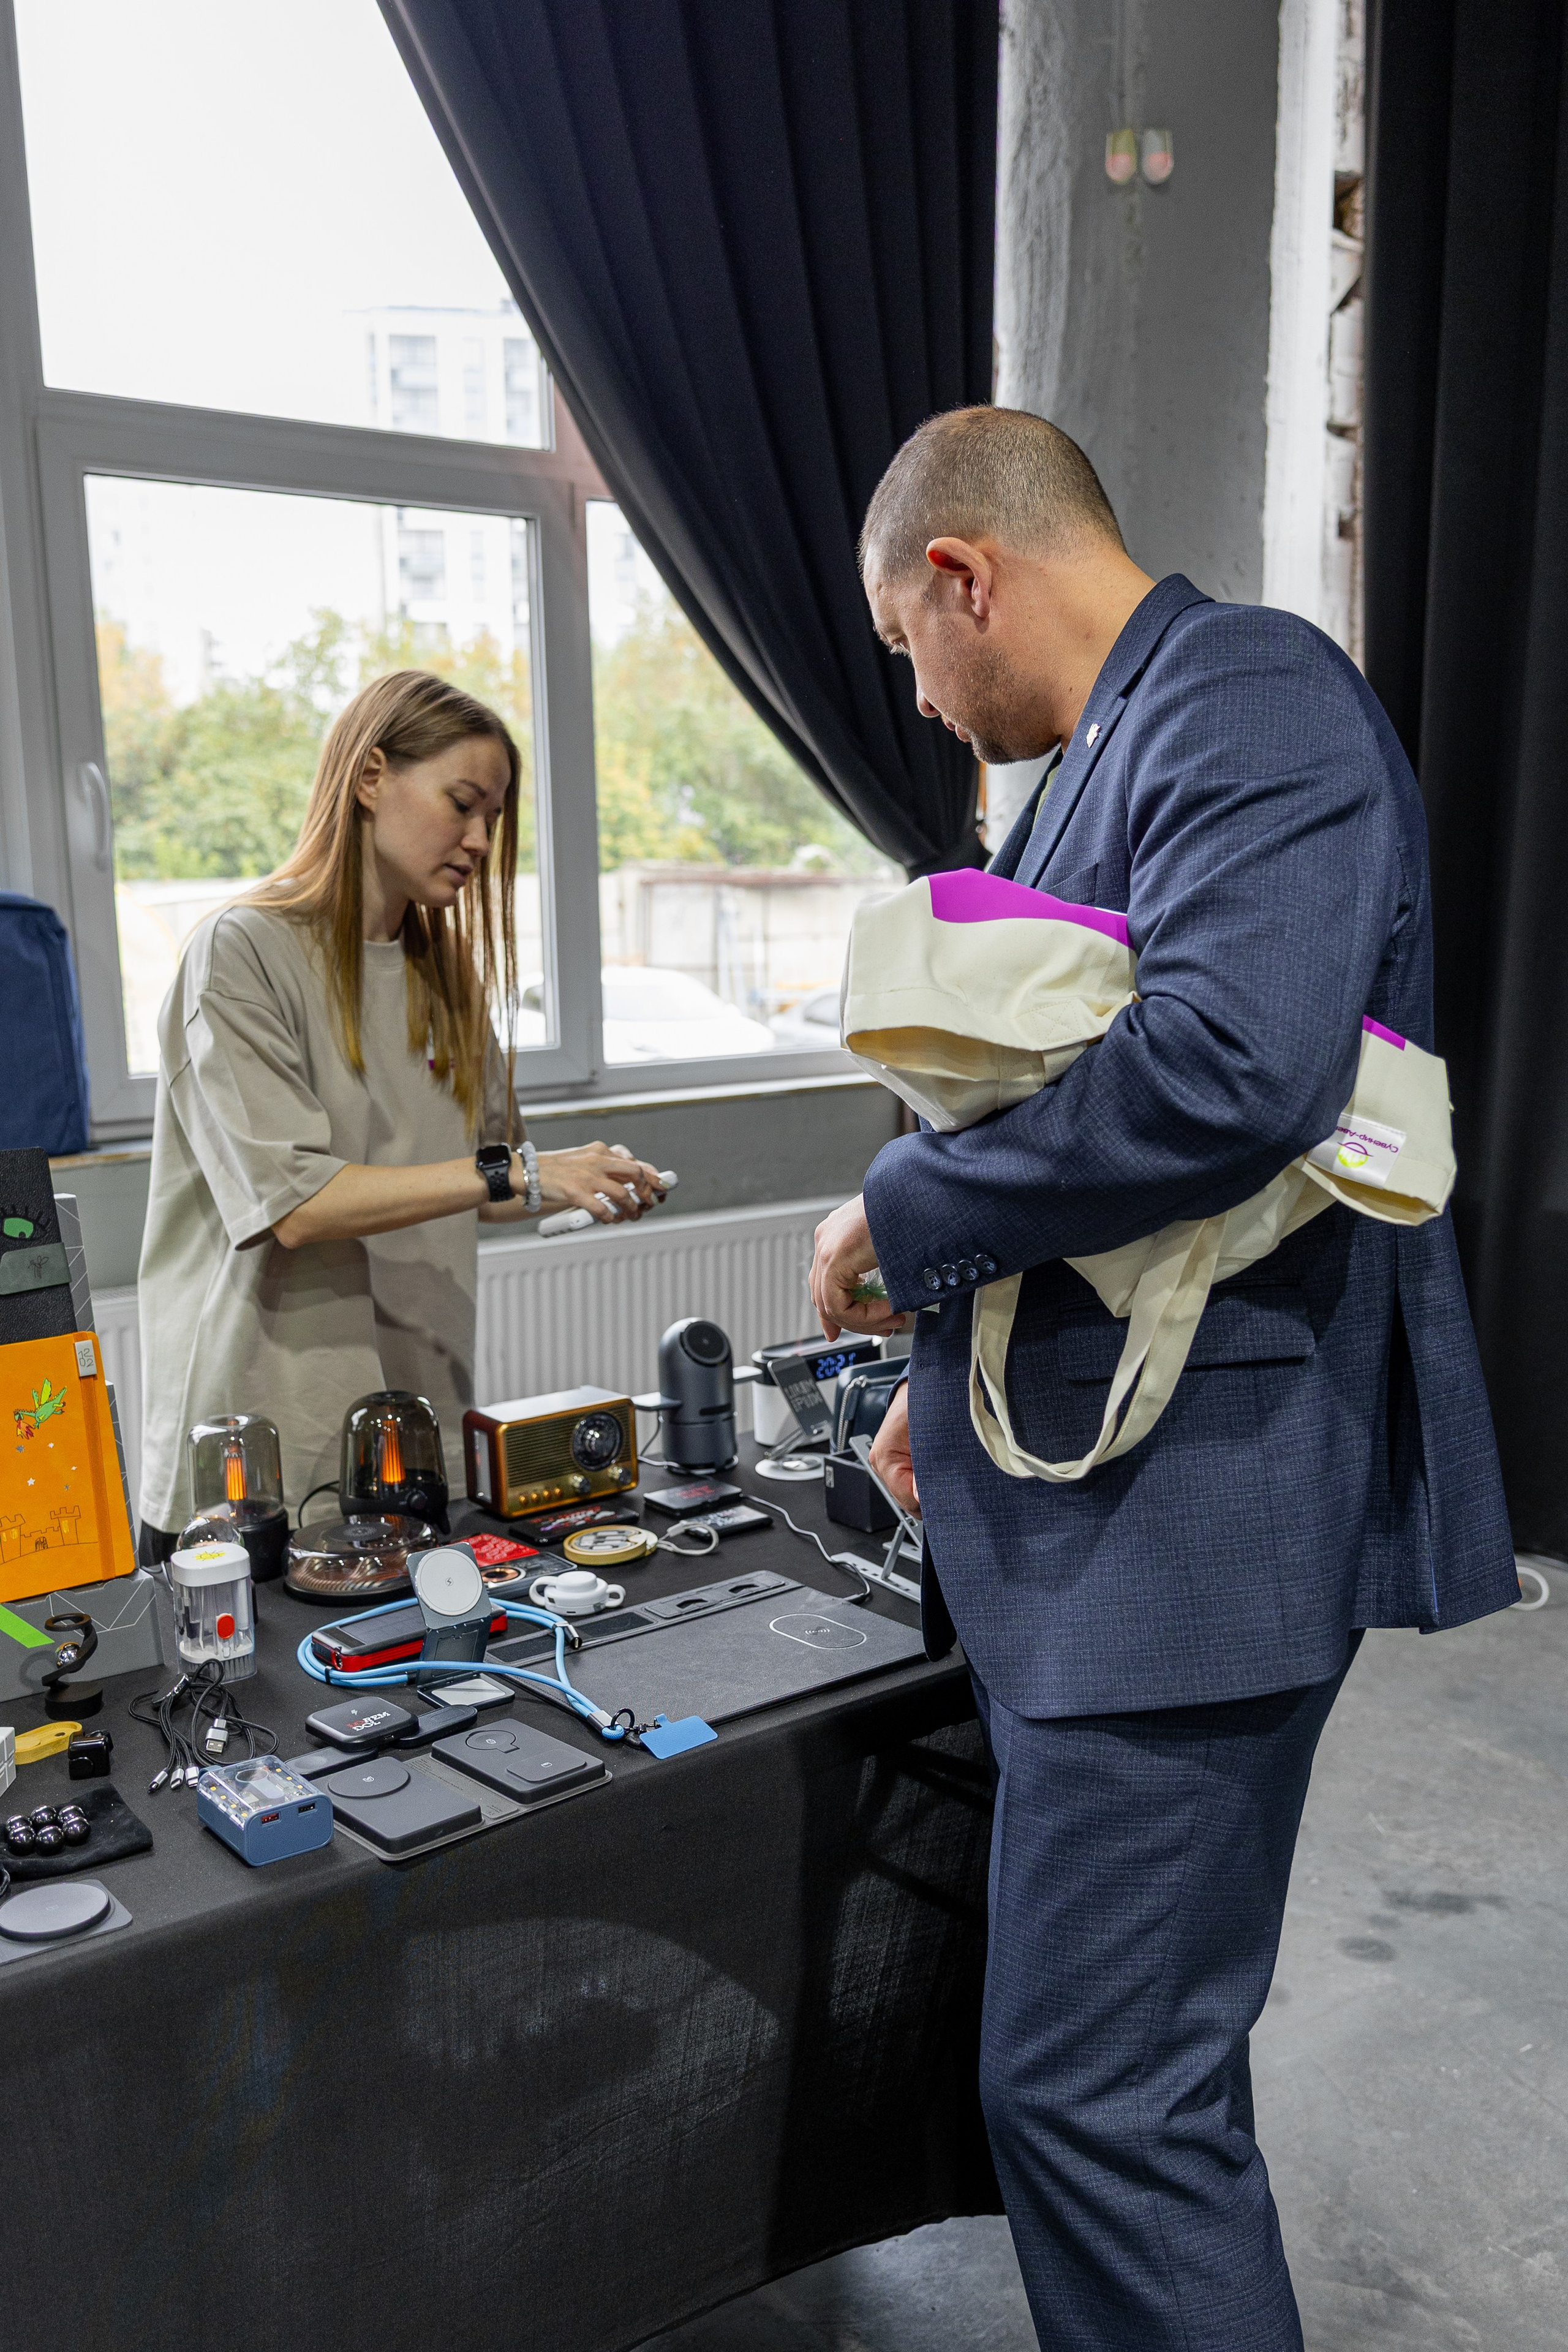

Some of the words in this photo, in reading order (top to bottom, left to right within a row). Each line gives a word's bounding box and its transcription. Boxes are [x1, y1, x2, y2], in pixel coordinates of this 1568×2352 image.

[78, 1348, 93, 1359] 12
[79, 1358, 94, 1368] 02
[347, 1711, 391, 1728] LOREM
